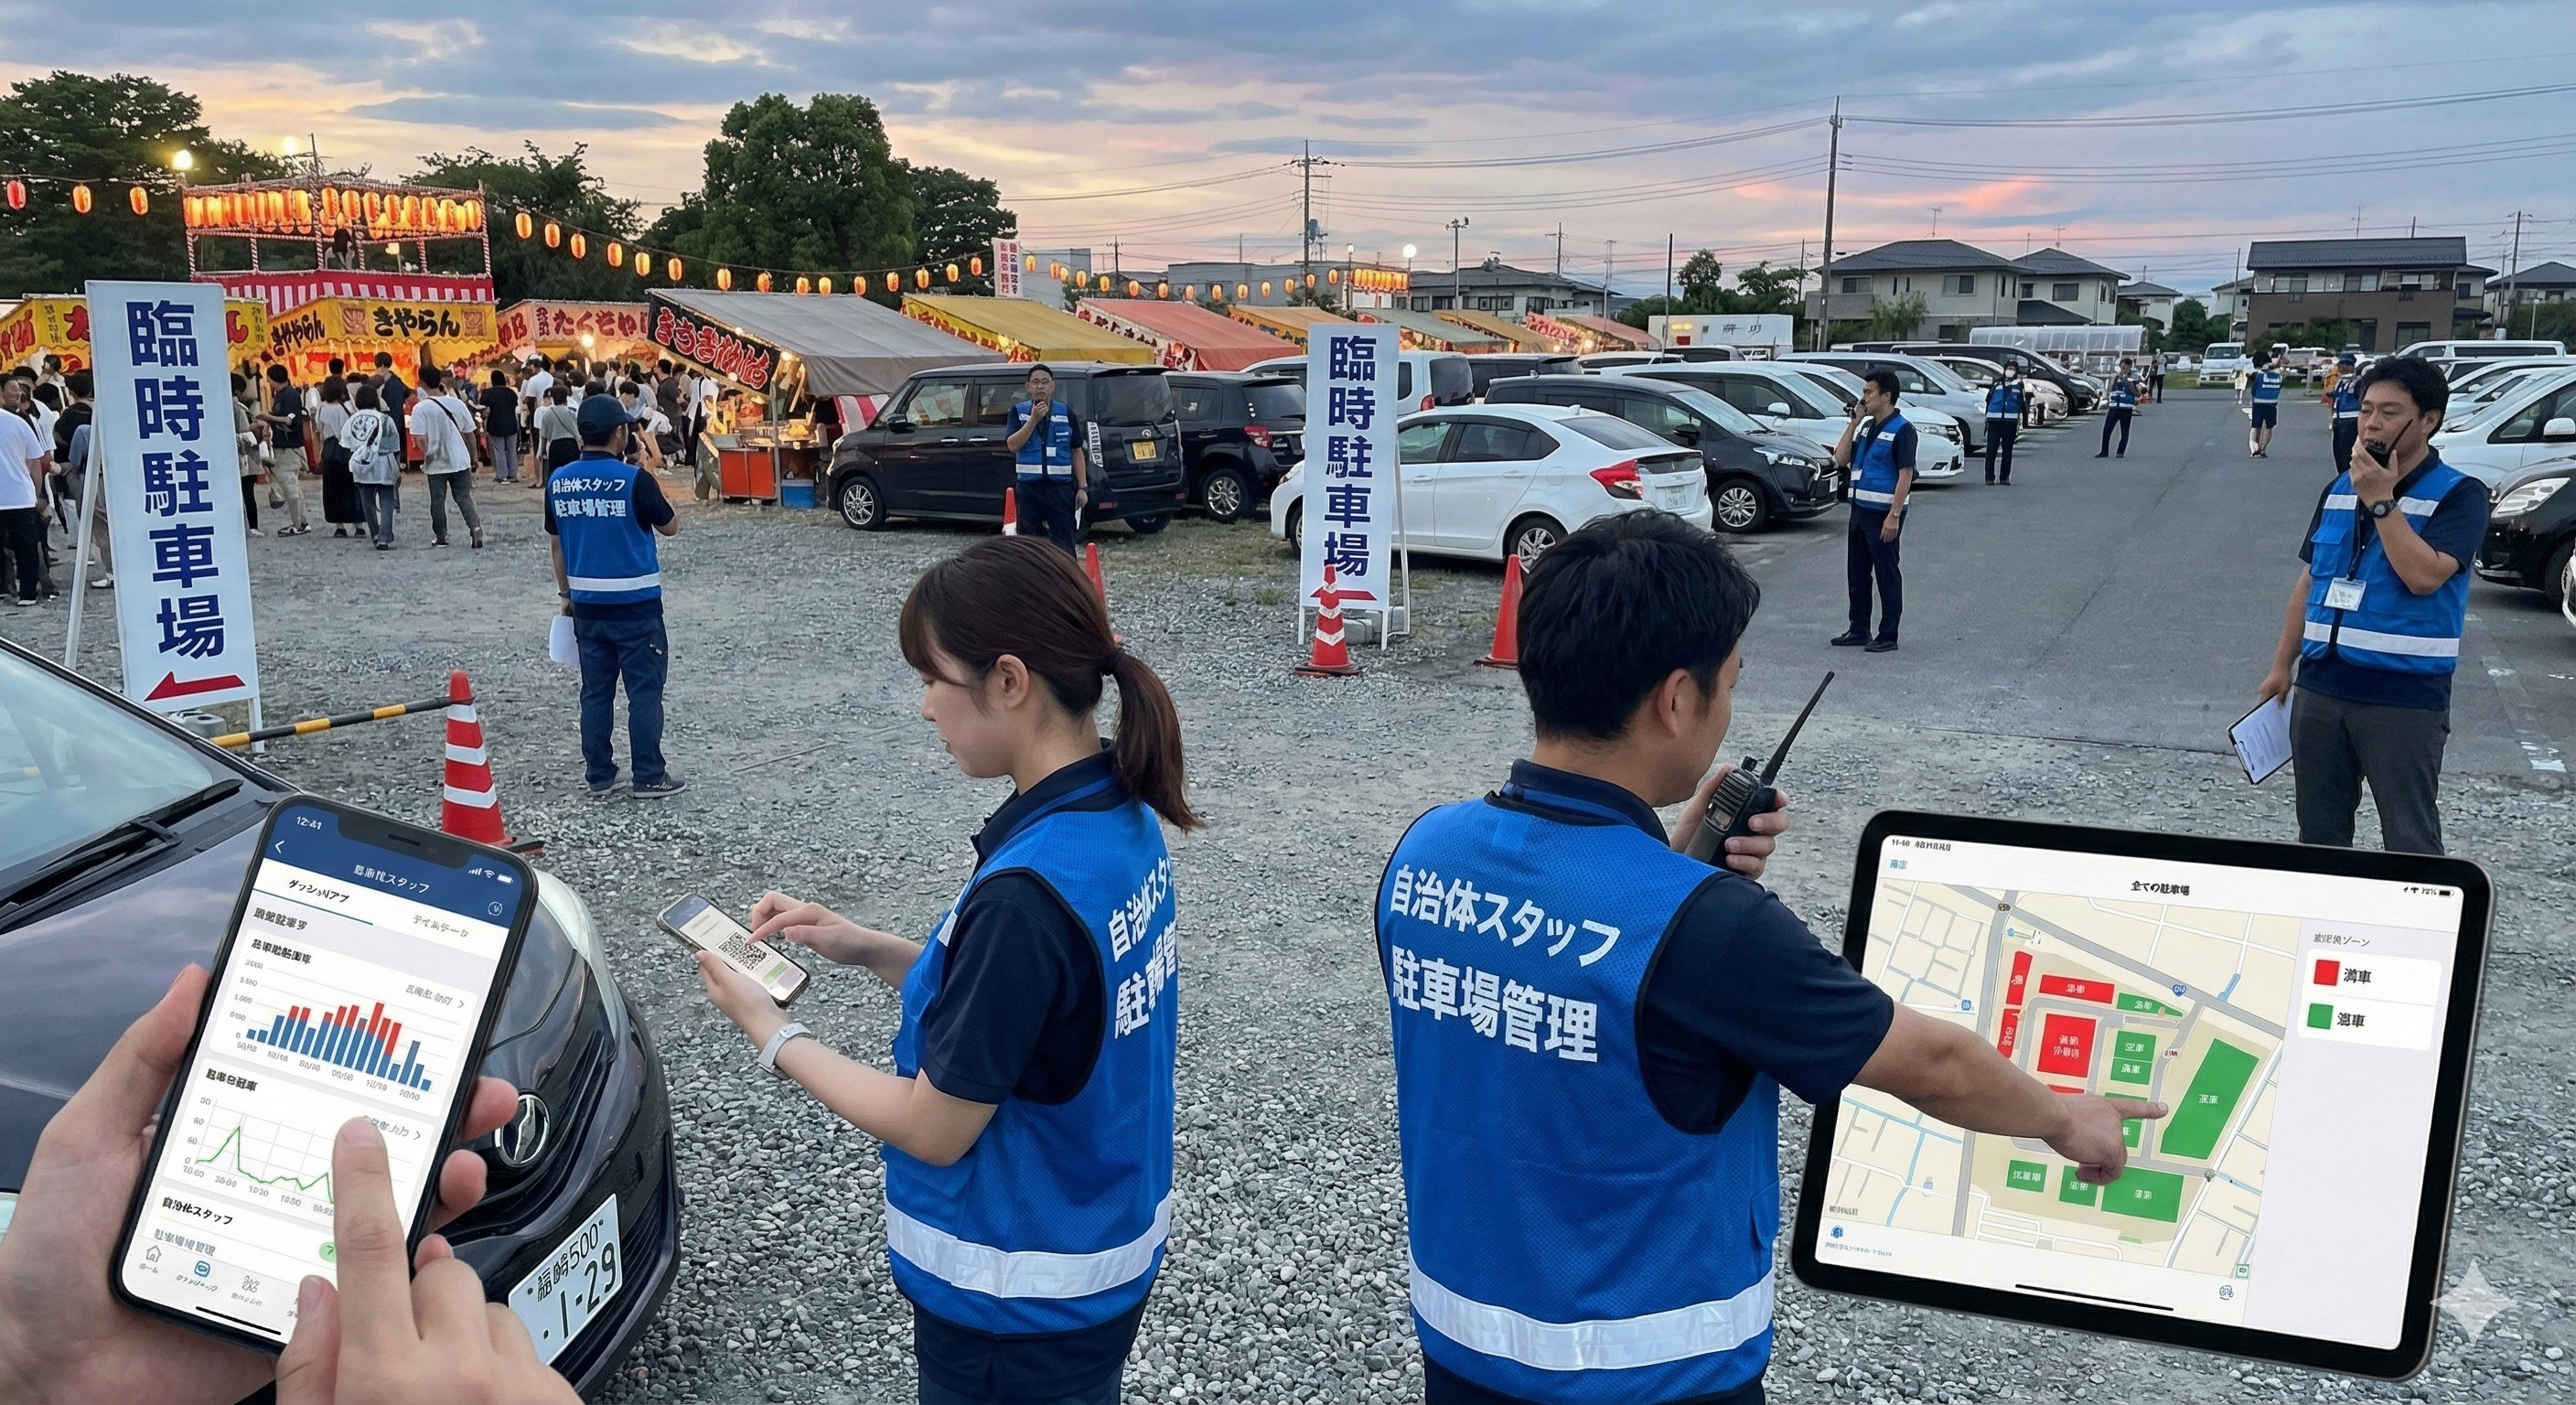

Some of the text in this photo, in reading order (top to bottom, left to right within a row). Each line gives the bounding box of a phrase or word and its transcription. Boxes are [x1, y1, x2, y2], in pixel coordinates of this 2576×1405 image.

[373, 306, 460, 338] きやらん
[126, 300, 225, 660] 臨時駐車場
[552, 477, 626, 495] 自治体スタッフ
[1324, 335, 1378, 577] 臨時駐車場
[1390, 864, 1621, 967] 自治体スタッフ
[1391, 945, 1598, 1063] 駐車場管理
